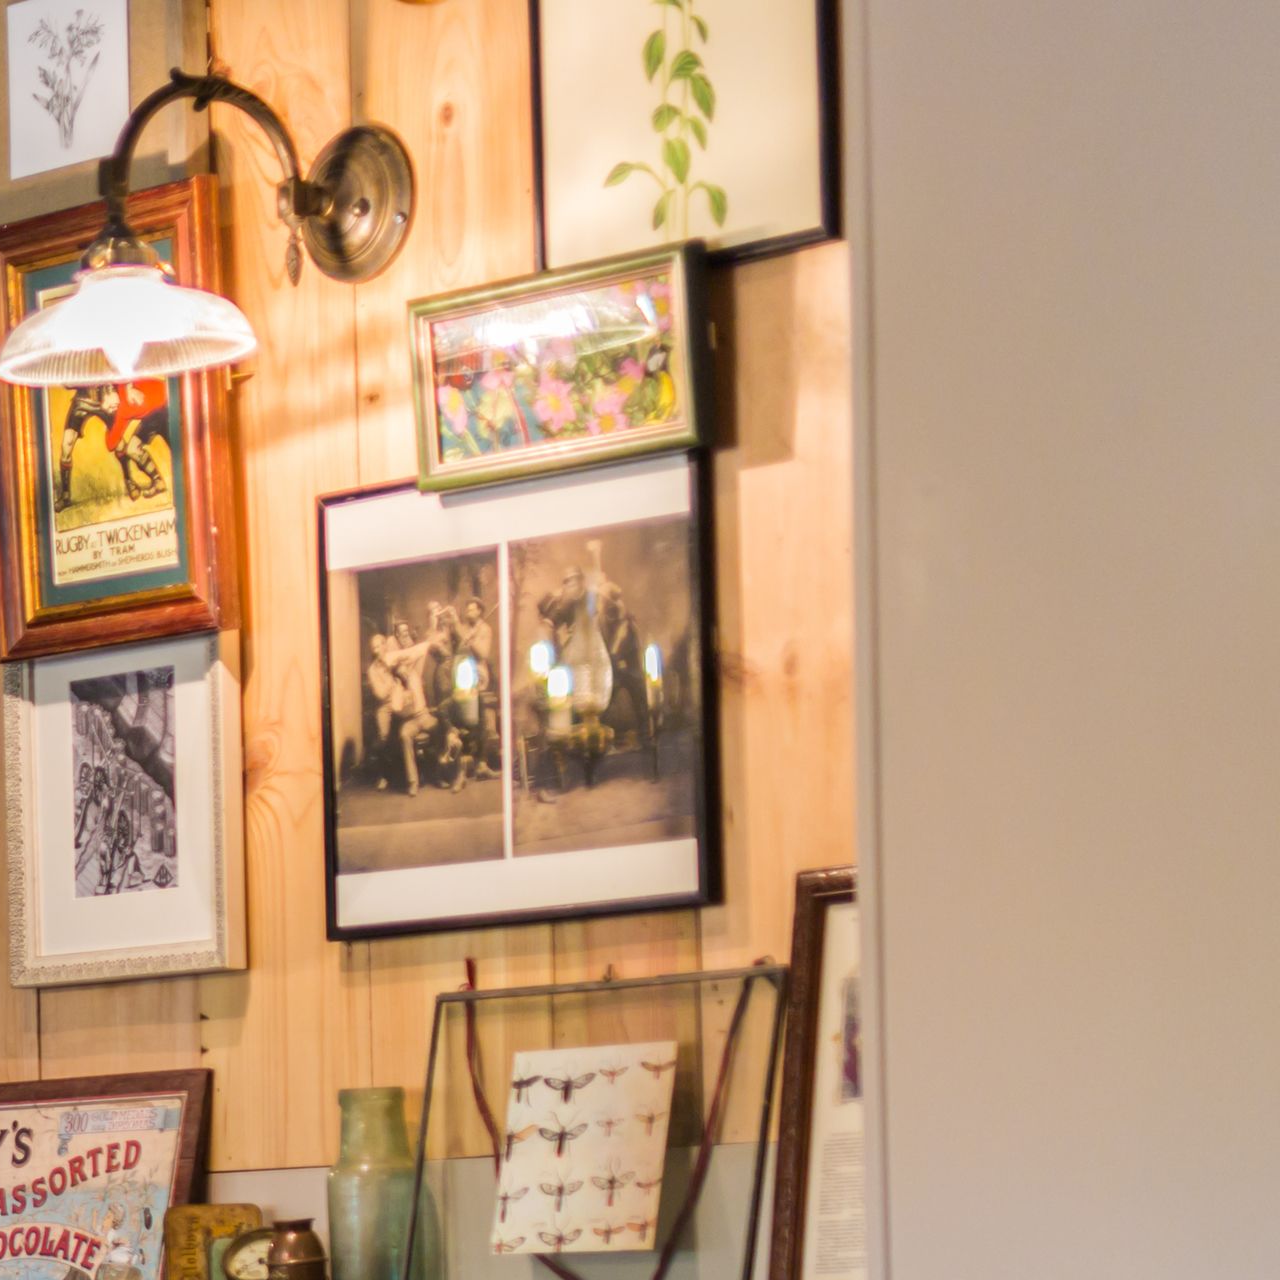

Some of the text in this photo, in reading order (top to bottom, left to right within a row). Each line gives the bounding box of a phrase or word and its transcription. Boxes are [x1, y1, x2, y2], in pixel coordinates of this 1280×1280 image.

[55, 533, 91, 556] RUGBY
[97, 518, 176, 547] TWICKENHAM
[93, 544, 136, 559] BY TRAM
[63, 1111, 89, 1134] 300
